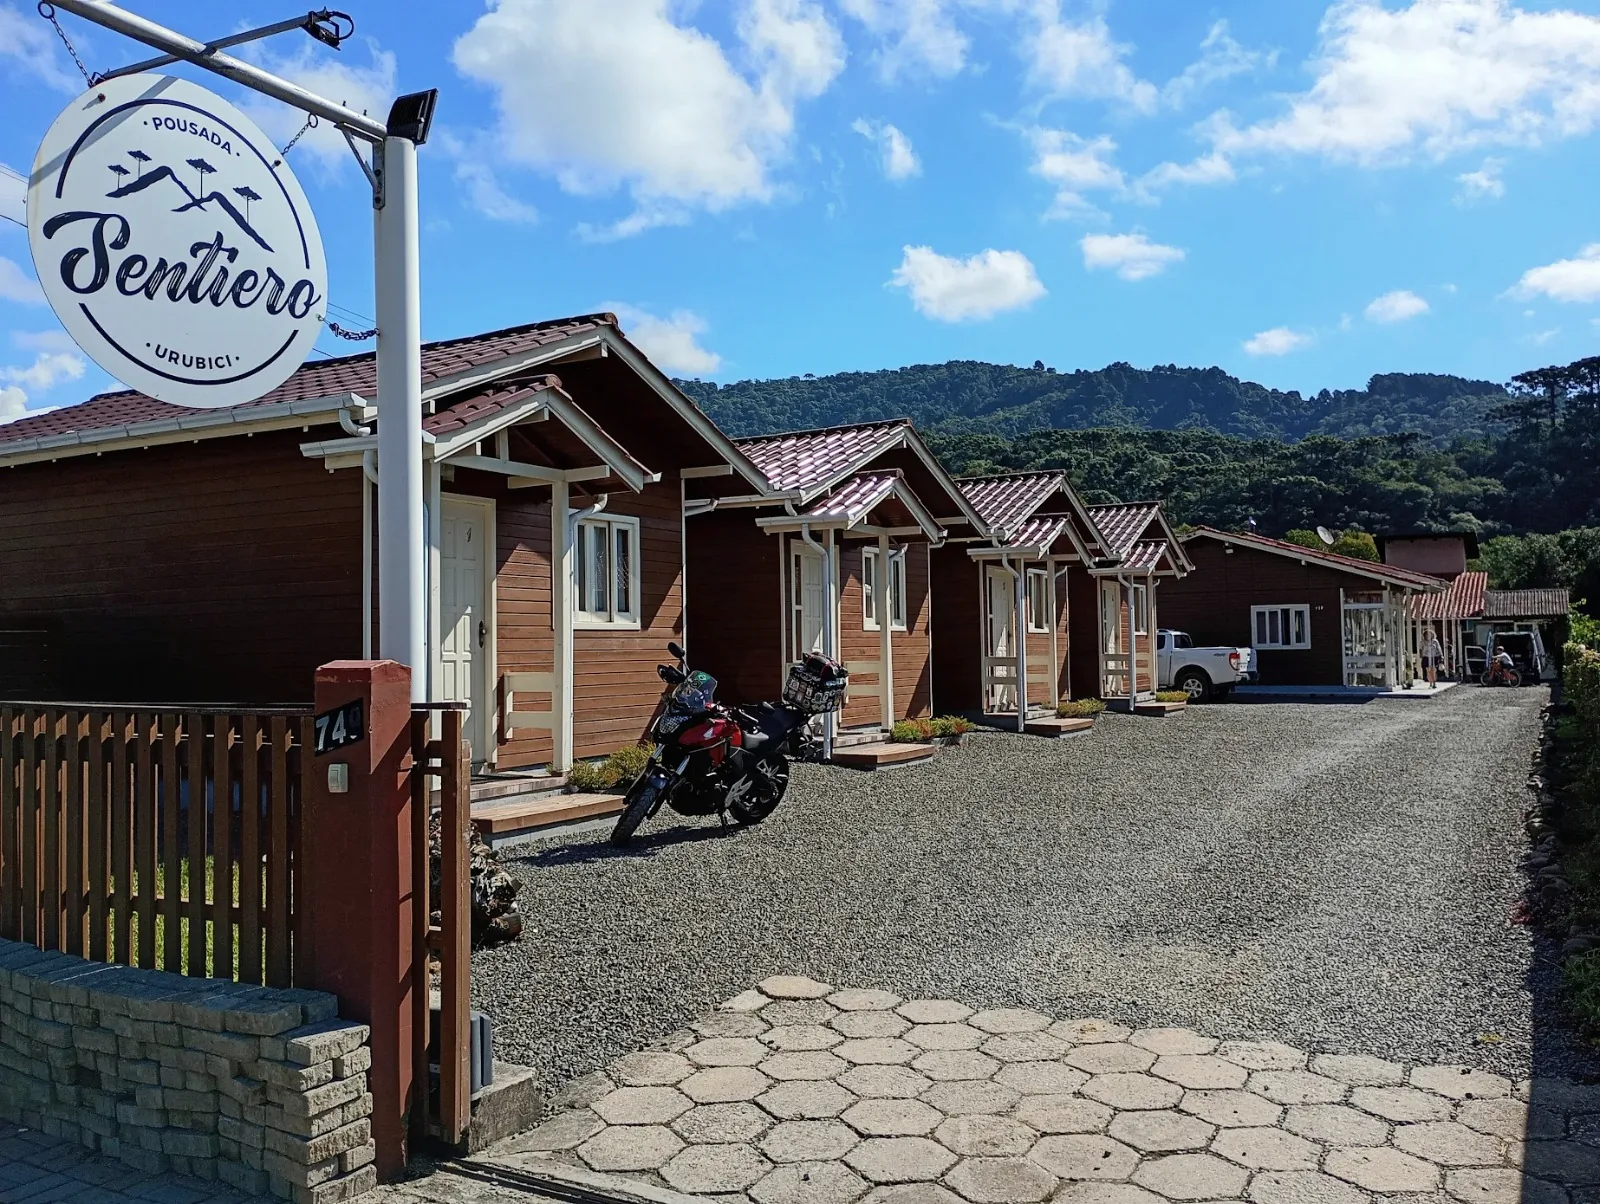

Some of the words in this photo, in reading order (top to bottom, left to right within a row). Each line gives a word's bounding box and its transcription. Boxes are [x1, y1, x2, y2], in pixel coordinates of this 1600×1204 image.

[152, 116, 232, 155] POUSADA
[42, 210, 322, 320] Sentiero
[154, 343, 232, 370] URUBICI
